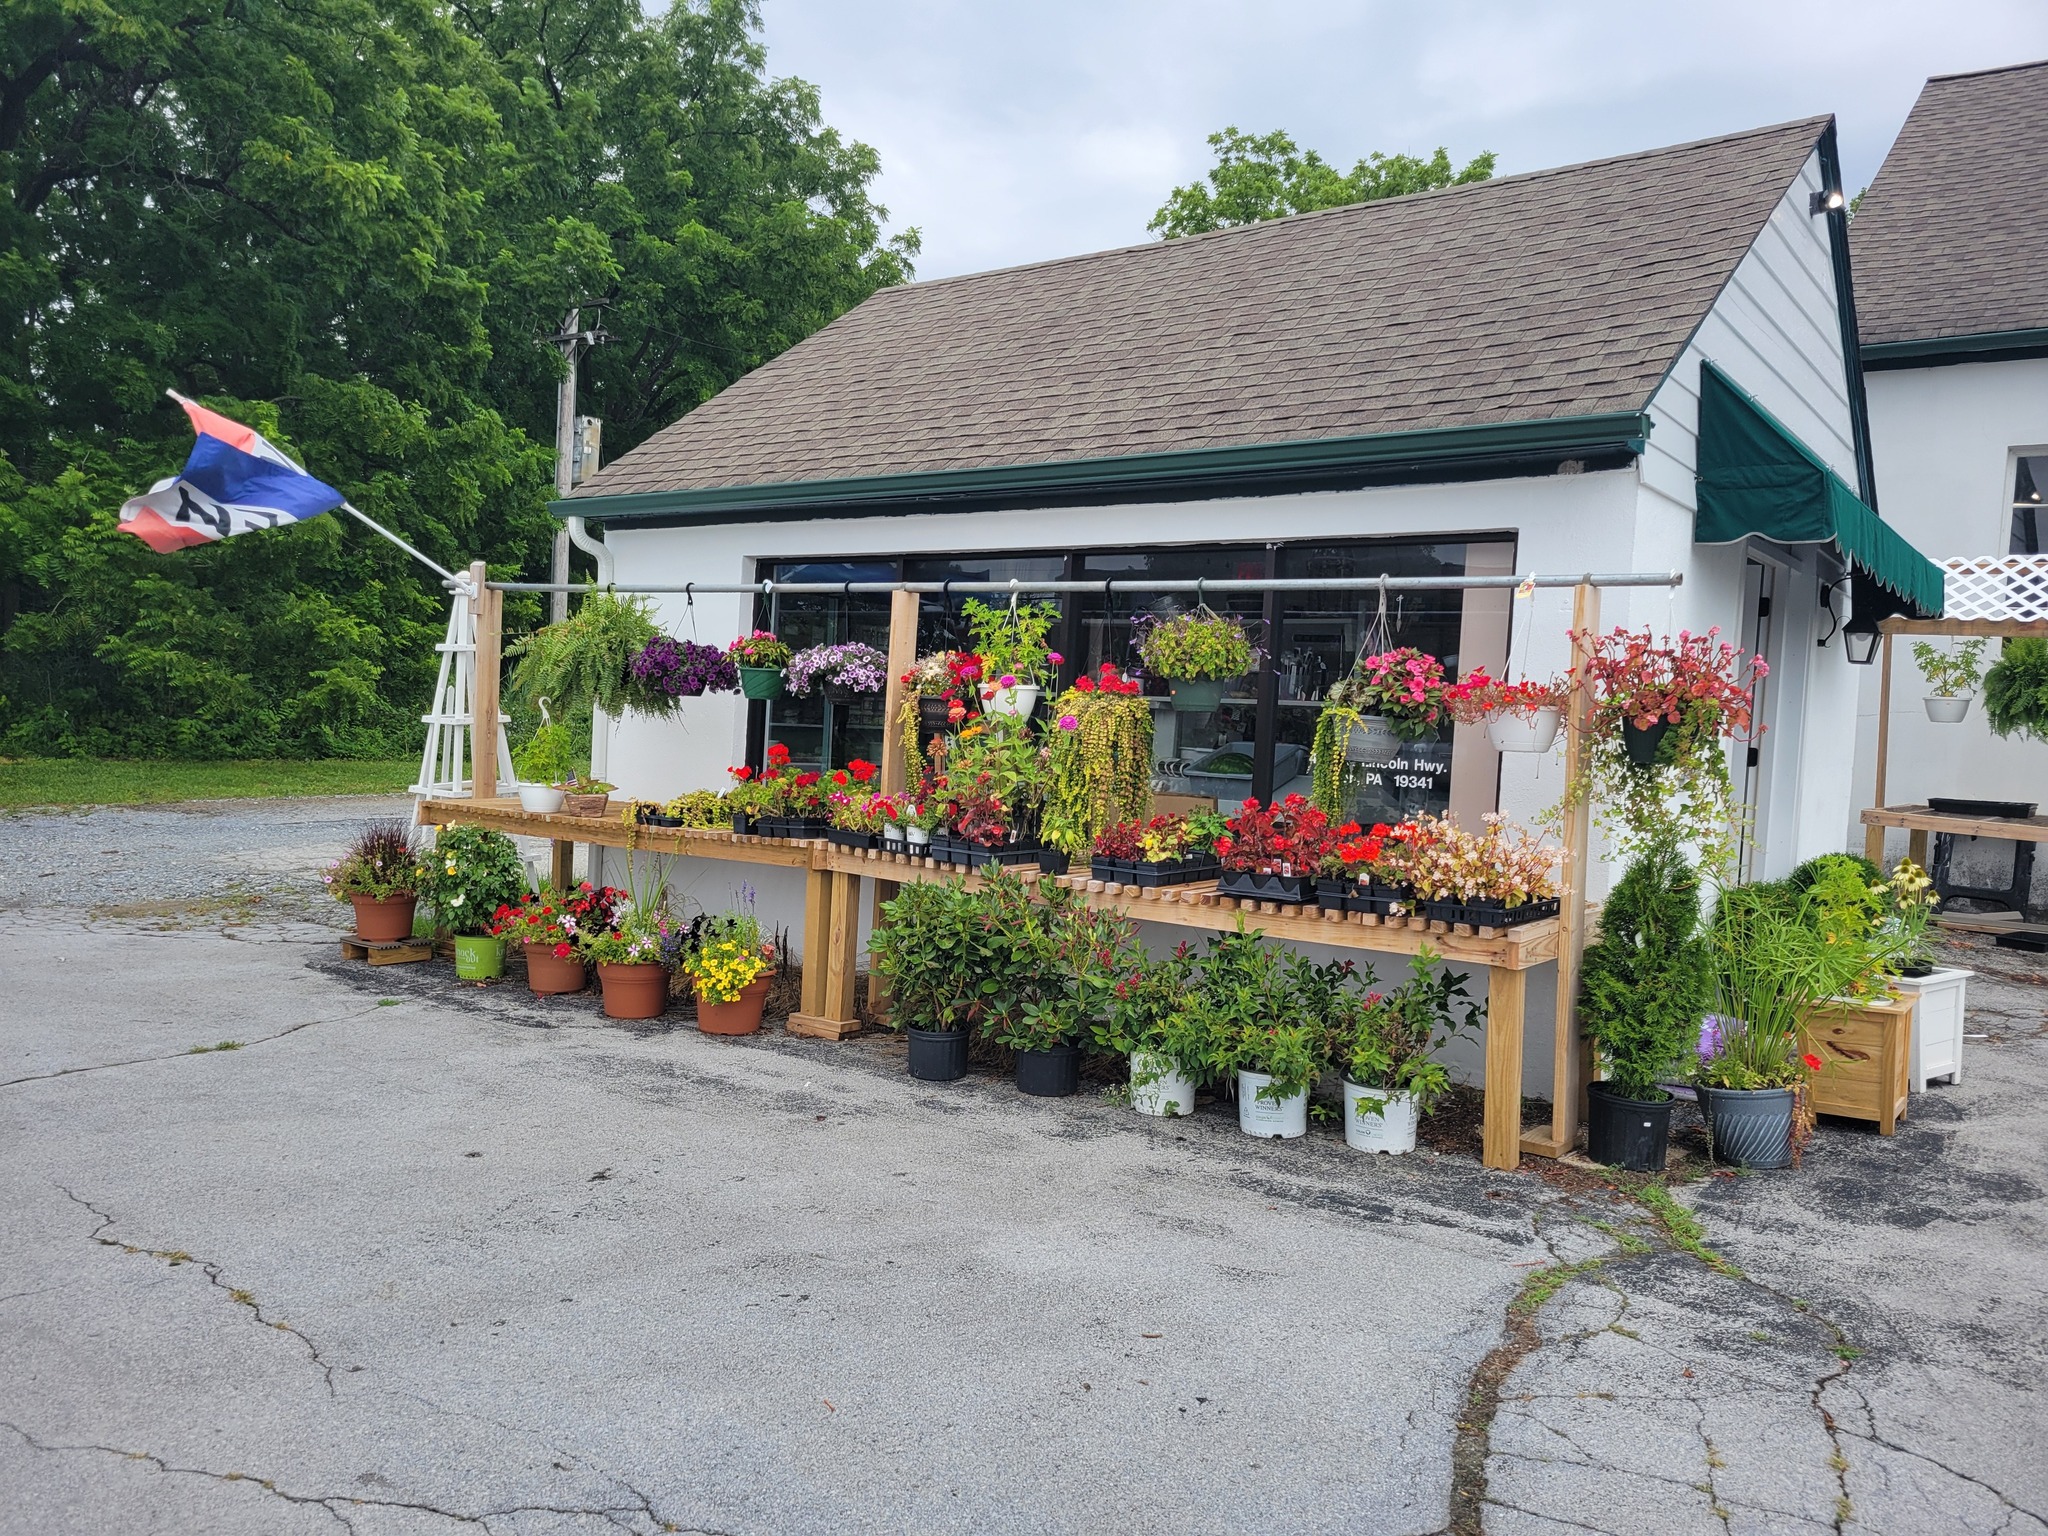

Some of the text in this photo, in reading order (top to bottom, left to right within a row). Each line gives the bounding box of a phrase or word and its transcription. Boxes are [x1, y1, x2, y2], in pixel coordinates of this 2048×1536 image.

[1414, 758, 1448, 775] Hwy.
[1366, 772, 1383, 786] PA
[1394, 774, 1433, 790] 19341
